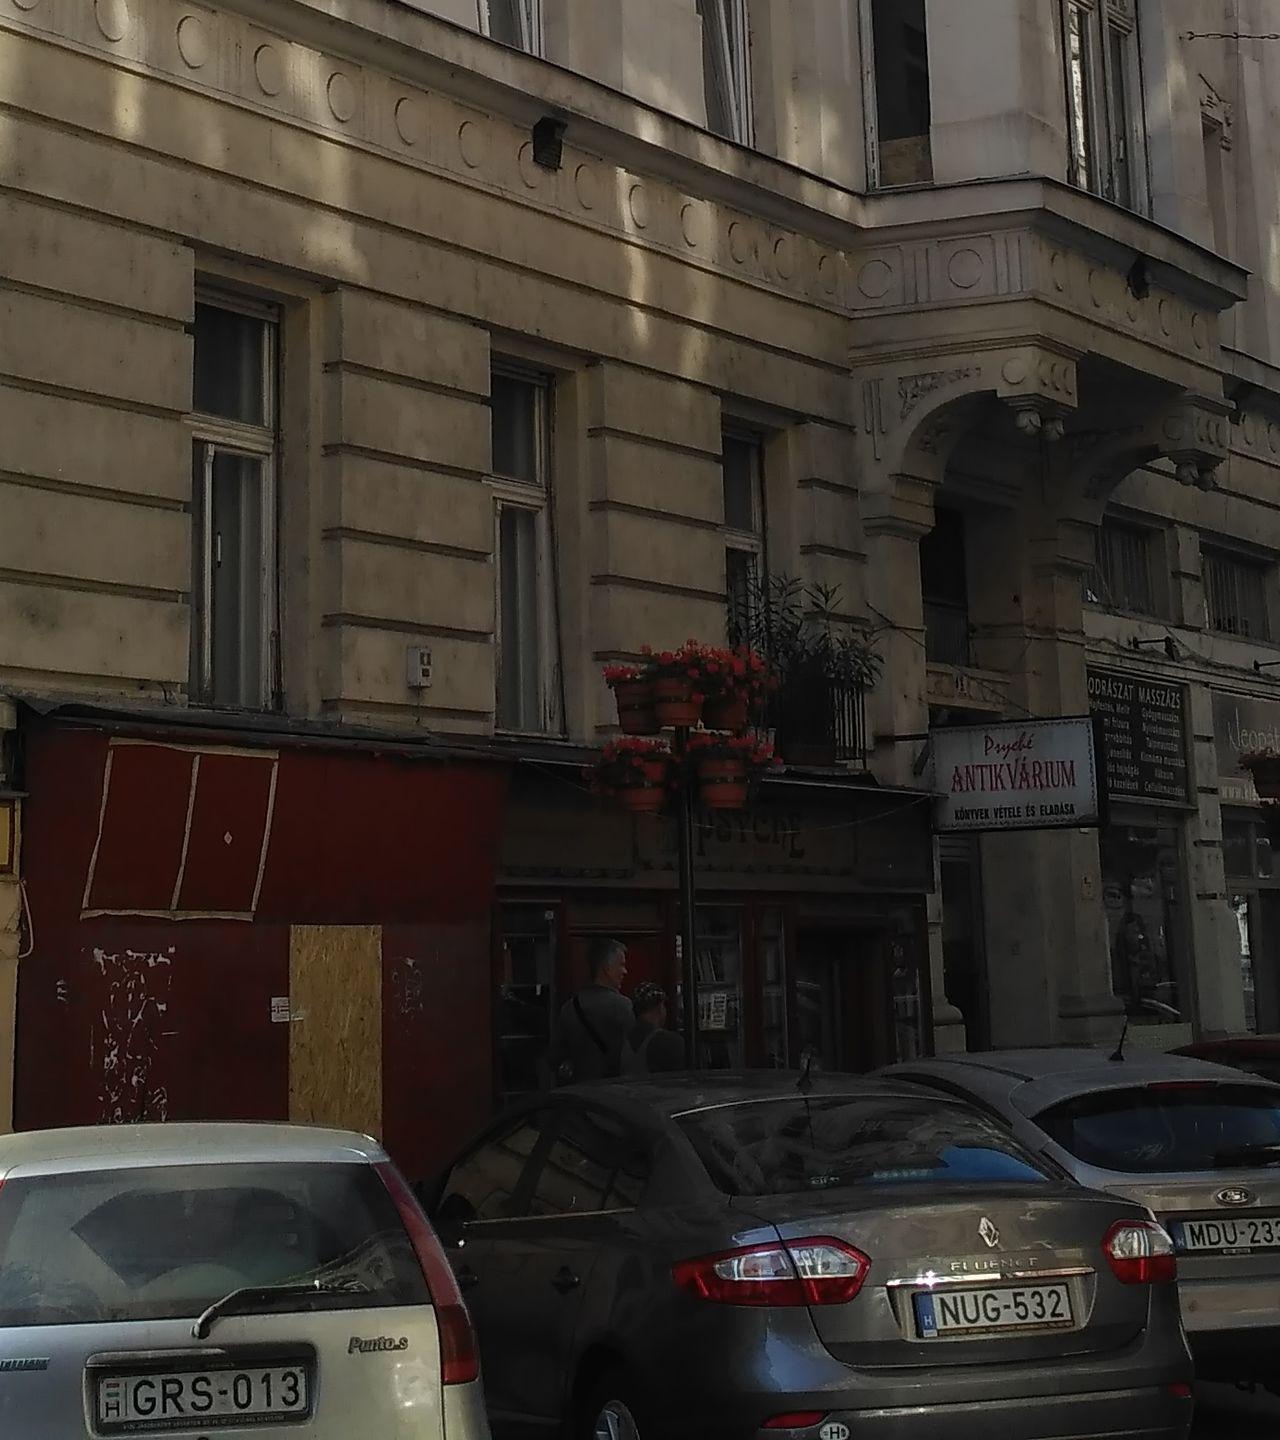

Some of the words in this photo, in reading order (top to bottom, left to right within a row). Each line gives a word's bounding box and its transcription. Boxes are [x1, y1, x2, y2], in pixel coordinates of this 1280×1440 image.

[1088, 677, 1133, 700] ODRÁSZAT
[1138, 686, 1180, 709] MASSZÁZS
[952, 757, 1076, 792] ANTIKVÁRIUM
[954, 806, 989, 821] KÖNYVEK
[994, 804, 1022, 819] VÉTELE
[1026, 803, 1035, 818] ÉS
[1040, 802, 1075, 816] ELADÁSA
[951, 1258, 1038, 1271] FLUENCE
[924, 1315, 933, 1327] H
[940, 1290, 1064, 1326] NUG-532
[106, 1401, 120, 1417] H
[133, 1371, 300, 1416] GRS-013
